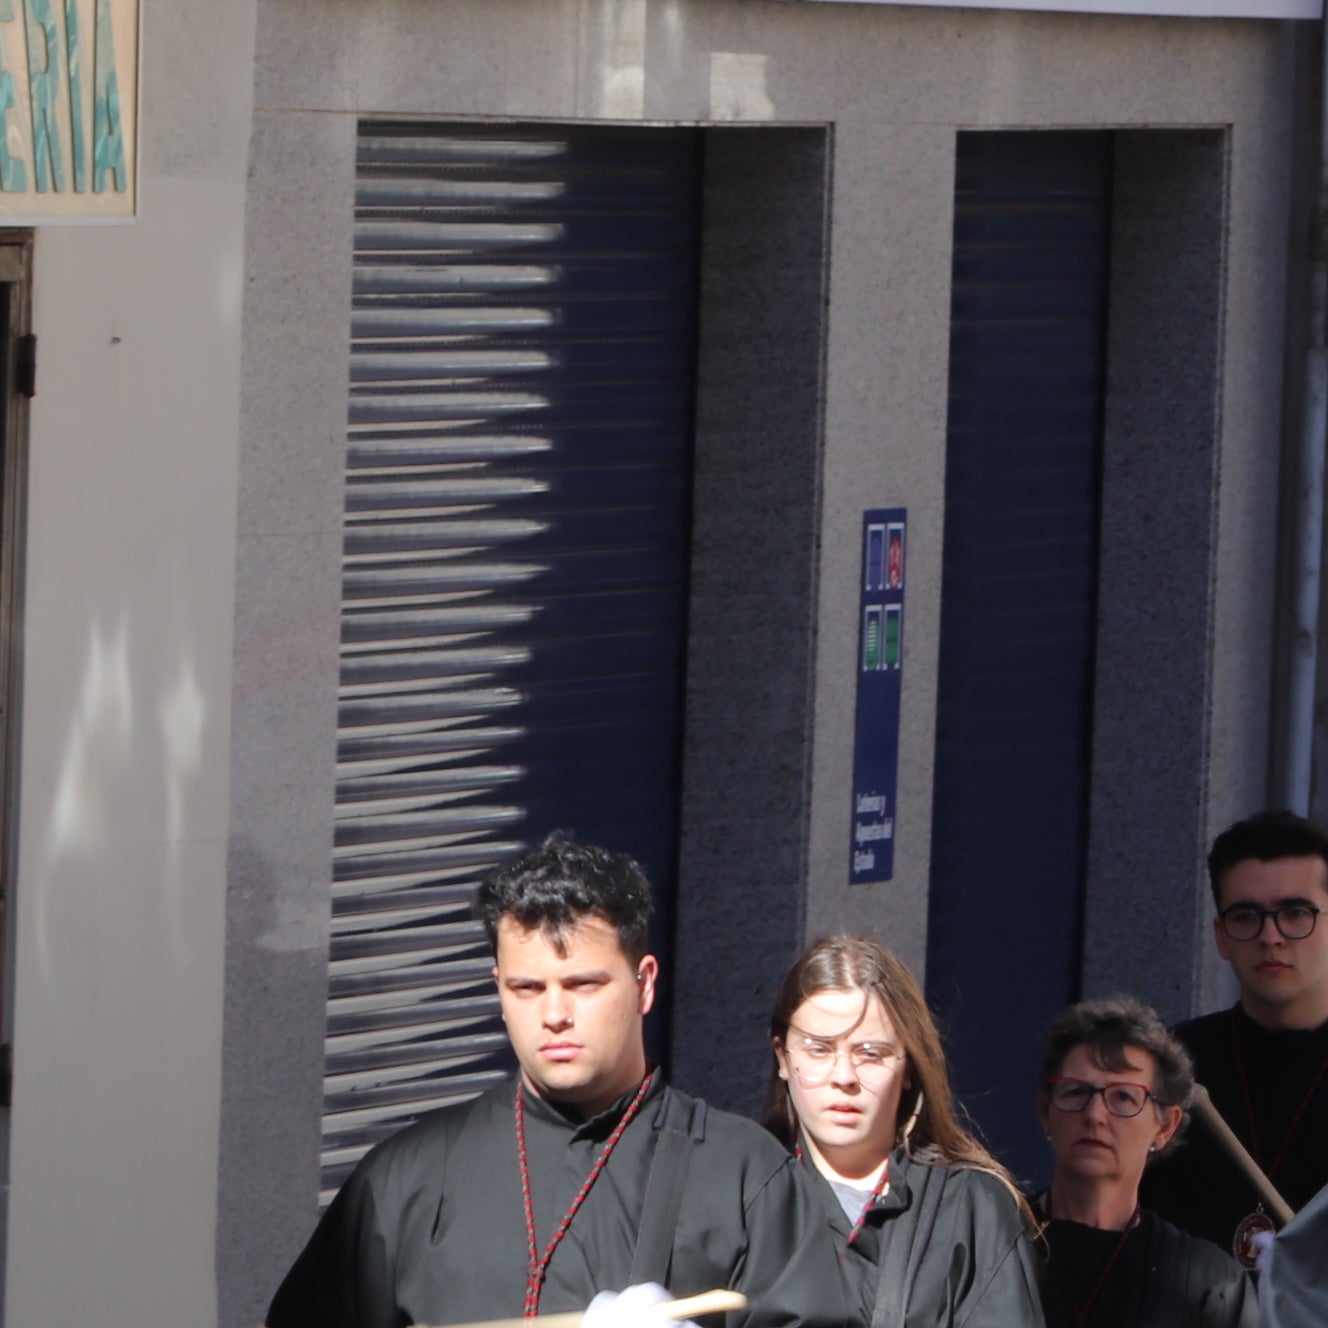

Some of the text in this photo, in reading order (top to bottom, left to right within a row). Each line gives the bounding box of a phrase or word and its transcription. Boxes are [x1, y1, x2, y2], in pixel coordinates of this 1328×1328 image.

[856, 790, 880, 813] Loterías
[856, 818, 893, 847] Apuestas del
[854, 849, 875, 874] Estado
